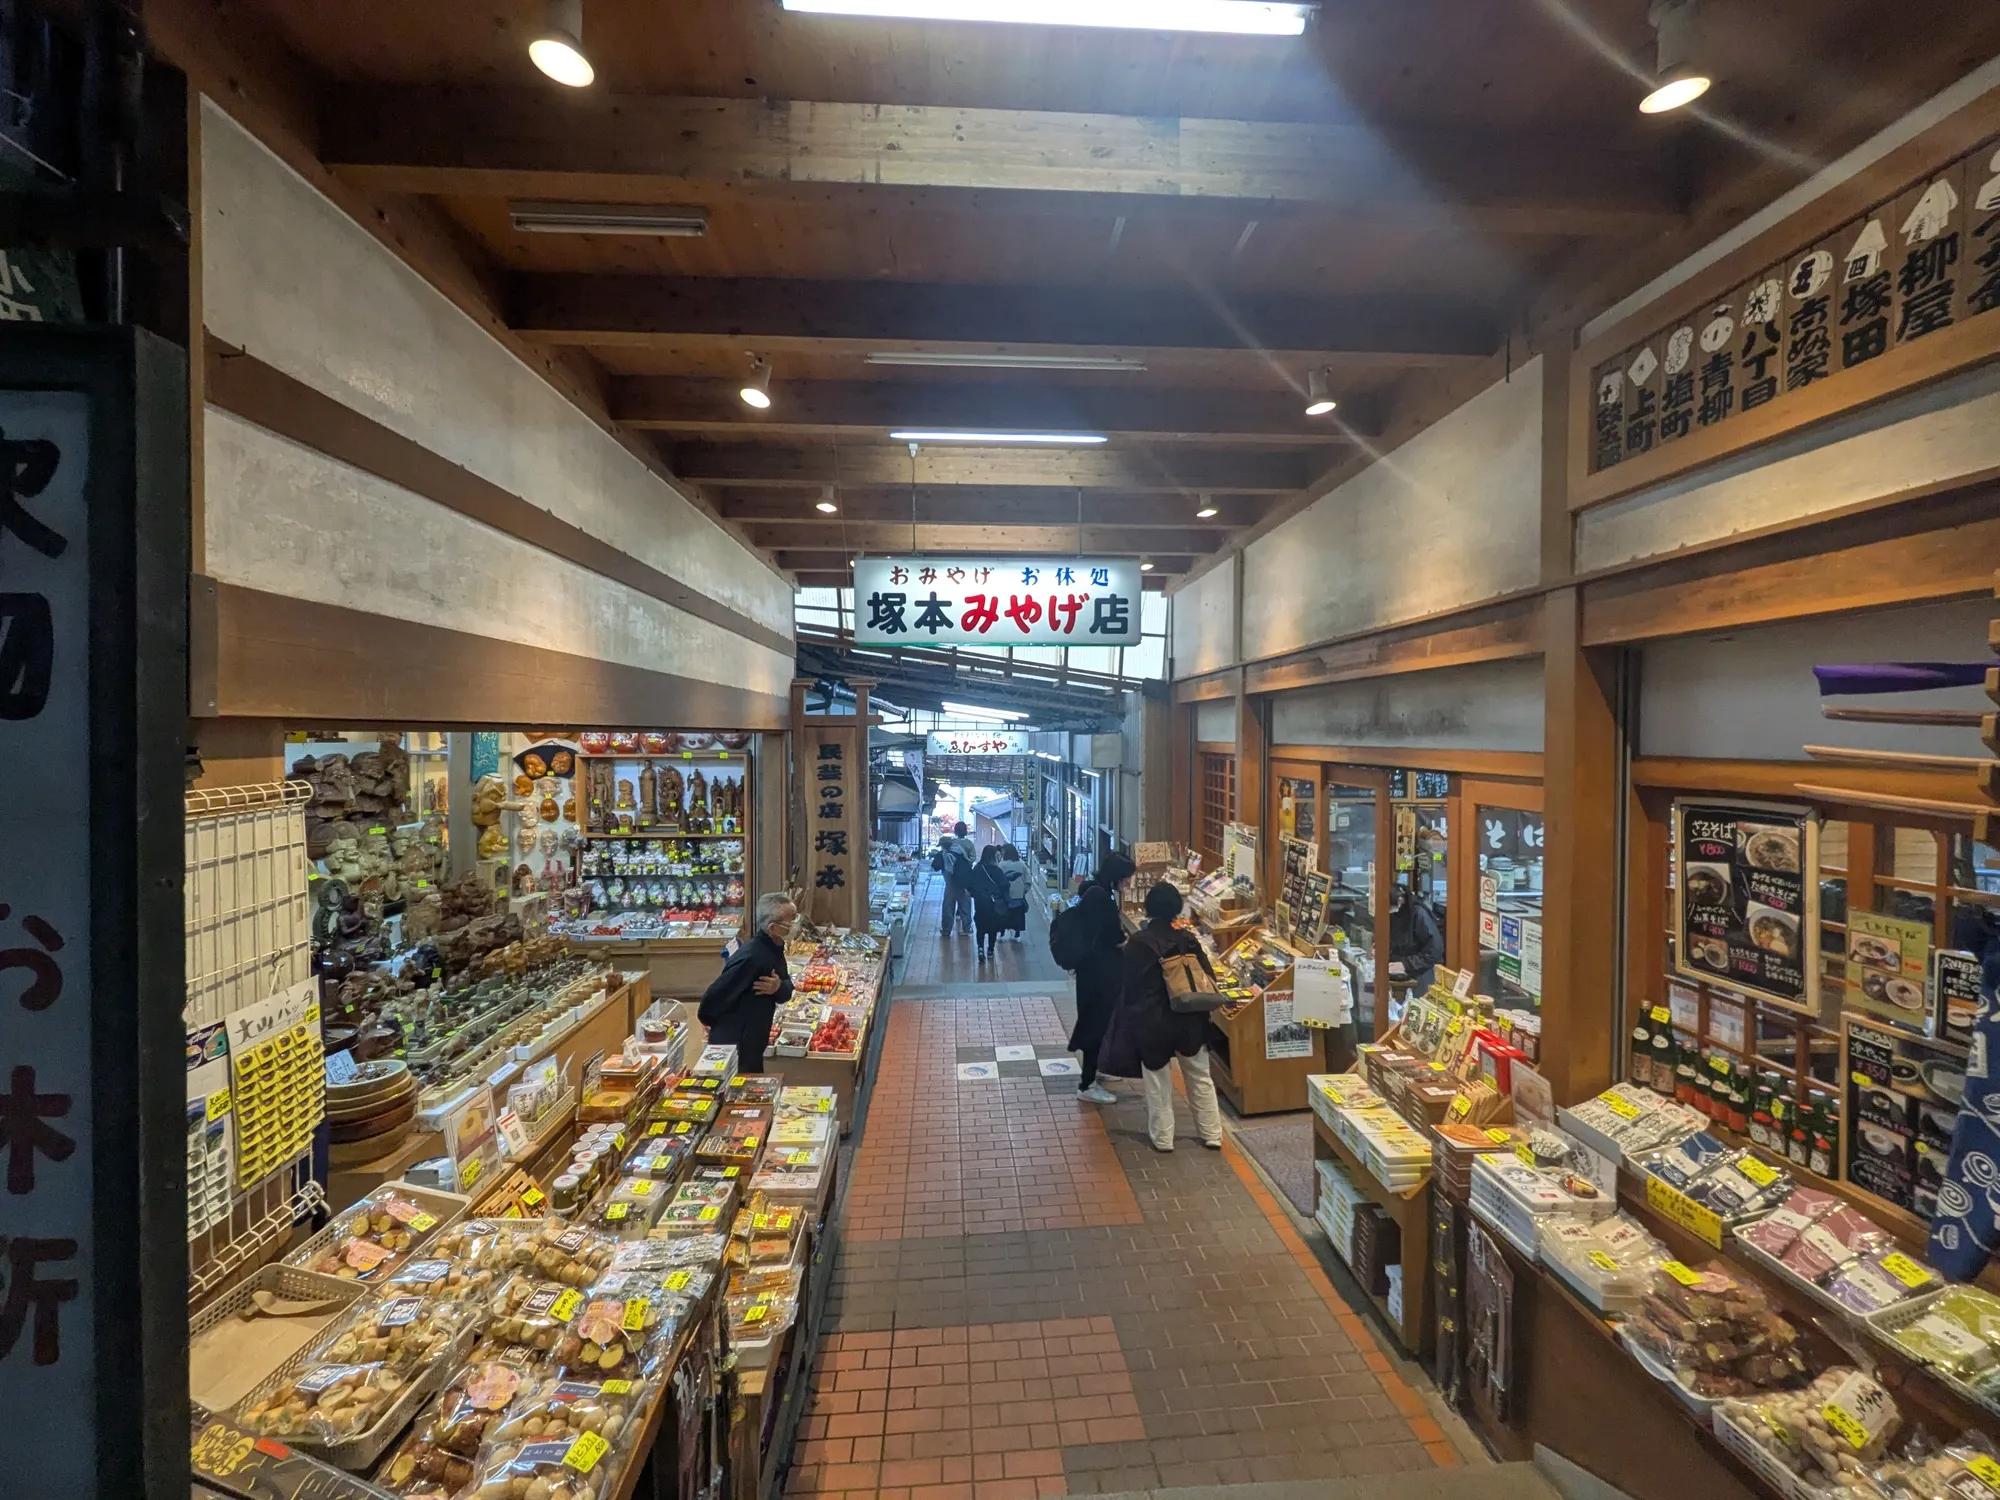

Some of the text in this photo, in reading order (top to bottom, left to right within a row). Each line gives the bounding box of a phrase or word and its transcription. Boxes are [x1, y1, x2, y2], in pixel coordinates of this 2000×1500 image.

[889, 565, 1109, 587] おみやげ お休処
[867, 591, 1129, 635] 塚本みやげ店
[1692, 820, 1736, 839] ざるそば
